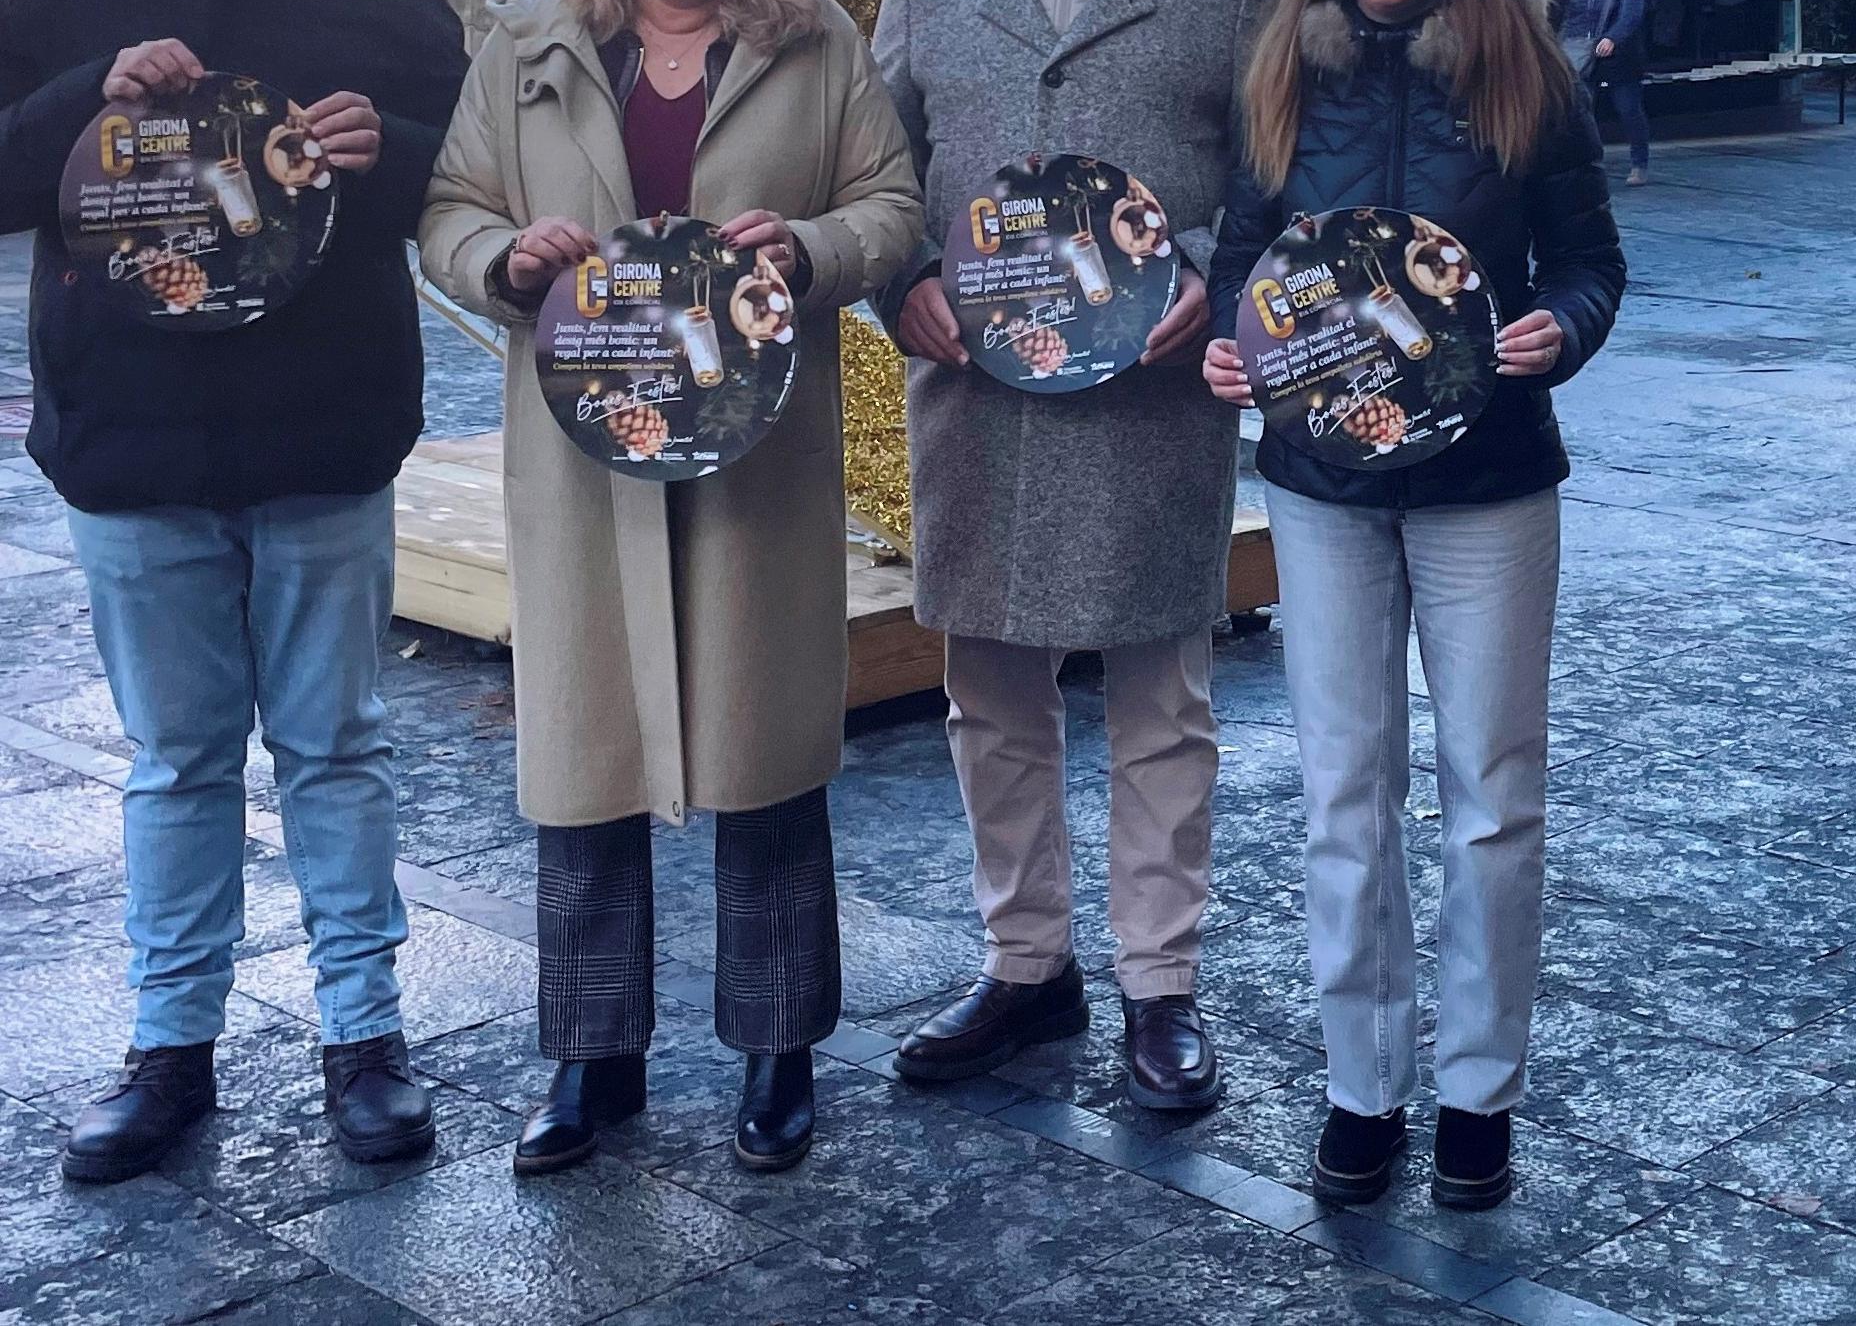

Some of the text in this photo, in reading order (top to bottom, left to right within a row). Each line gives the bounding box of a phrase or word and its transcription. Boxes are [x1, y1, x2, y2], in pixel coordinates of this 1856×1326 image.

[139, 118, 190, 137] GIRONA
[140, 135, 191, 154] CENTRE
[1001, 197, 1046, 217] GIRONA
[1004, 213, 1048, 232] CENTRE
[613, 262, 663, 280] GIRONA
[956, 251, 1053, 273] Junts, fem realitat el
[958, 273, 984, 285] desig
[985, 269, 1004, 280] més
[1036, 265, 1050, 274] un
[1284, 262, 1334, 294] GIRONA
[613, 280, 663, 297] CENTRE
[959, 284, 983, 296] regal
[984, 283, 1000, 294] per
[1001, 281, 1008, 290] a
[1009, 277, 1033, 288] cada
[1291, 277, 1341, 309] CENTRE
[553, 322, 663, 335] Junts, fem realitat el
[554, 335, 583, 347] desig
[585, 335, 606, 345] més
[643, 337, 658, 345] un
[1256, 315, 1356, 367] Junts, fem realitat el
[554, 347, 581, 360] regal
[583, 349, 602, 360] per
[602, 349, 610, 358] a
[611, 347, 637, 358] cada
[1261, 359, 1288, 377] desig
[1288, 350, 1309, 365] més
[1342, 332, 1357, 343] un
[1265, 370, 1291, 388] regal
[1291, 364, 1309, 380] per
[1309, 361, 1317, 370] a
[1318, 350, 1342, 367] cada
